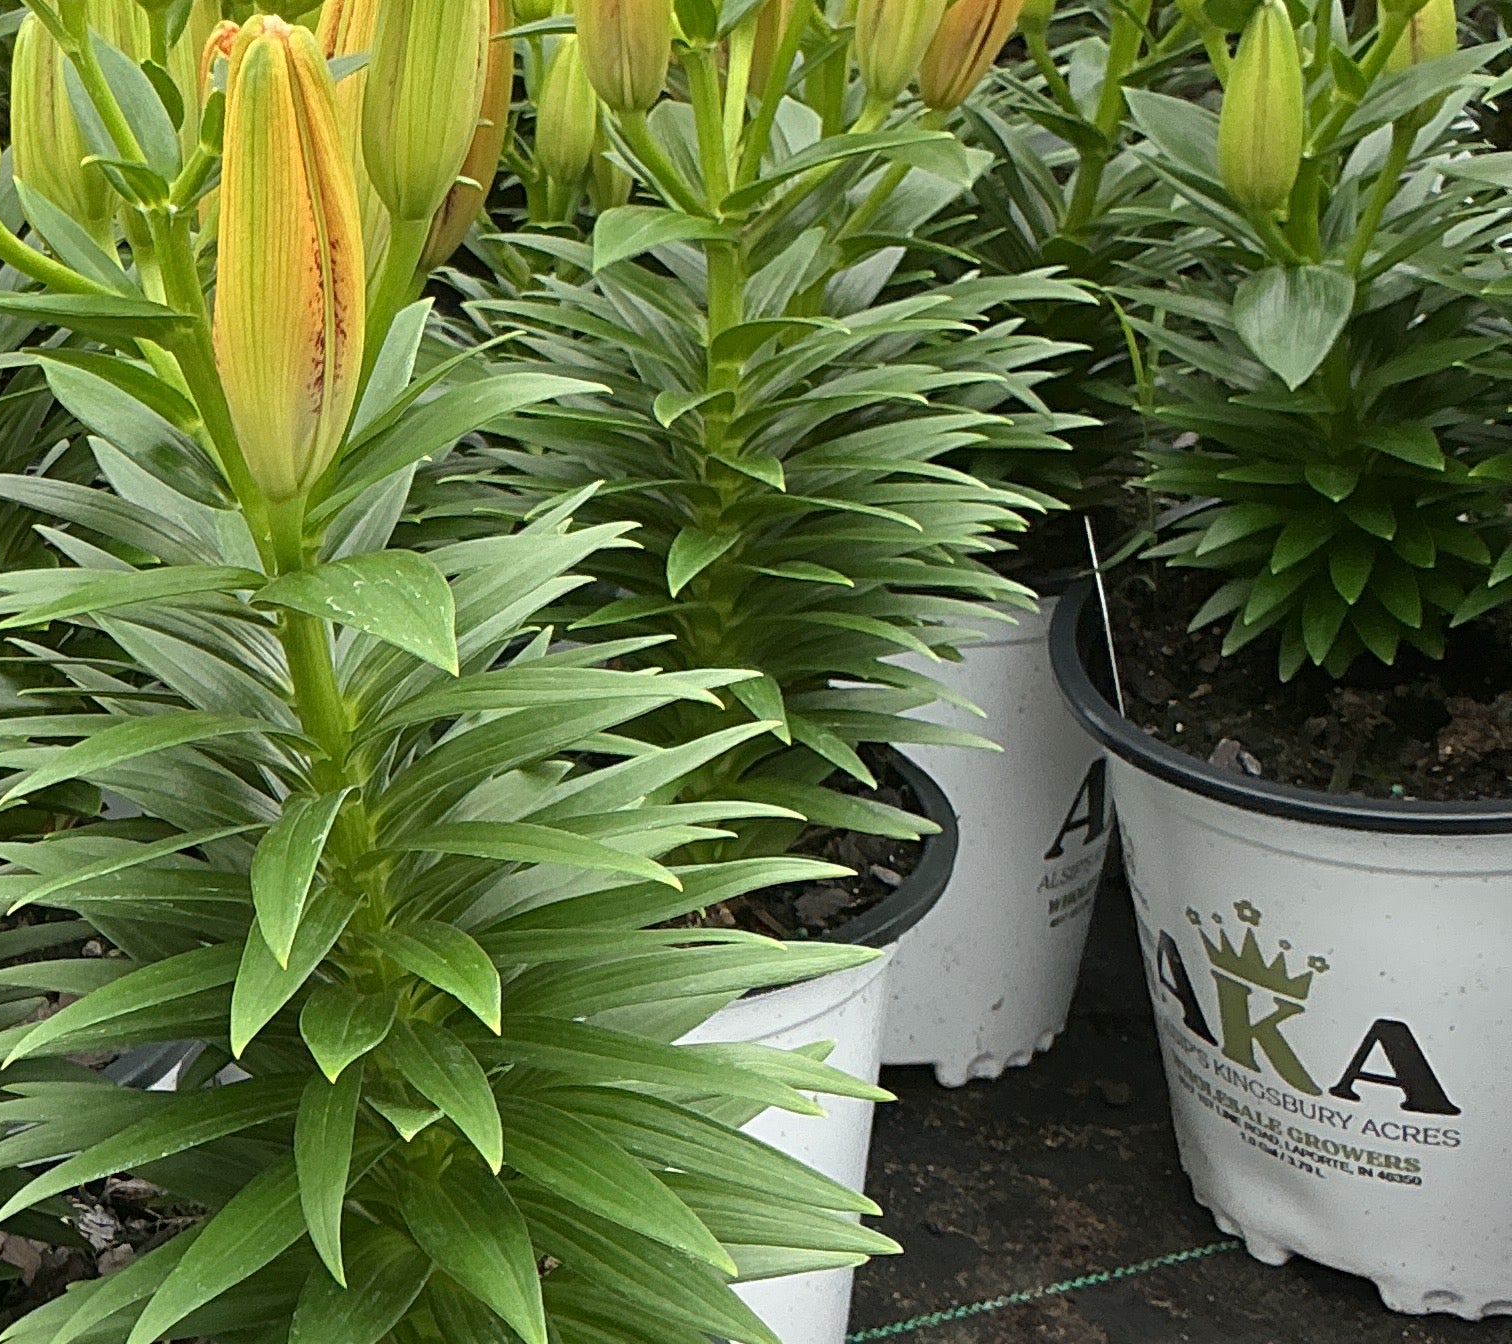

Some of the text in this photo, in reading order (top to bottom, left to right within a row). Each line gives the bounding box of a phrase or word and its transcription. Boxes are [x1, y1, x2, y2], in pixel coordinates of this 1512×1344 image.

[1157, 929, 1462, 1116] AKA
[1213, 1059, 1353, 1130] KINGSBURY
[1361, 1119, 1461, 1148] ACRES
[1288, 1126, 1422, 1174] GROWERS
